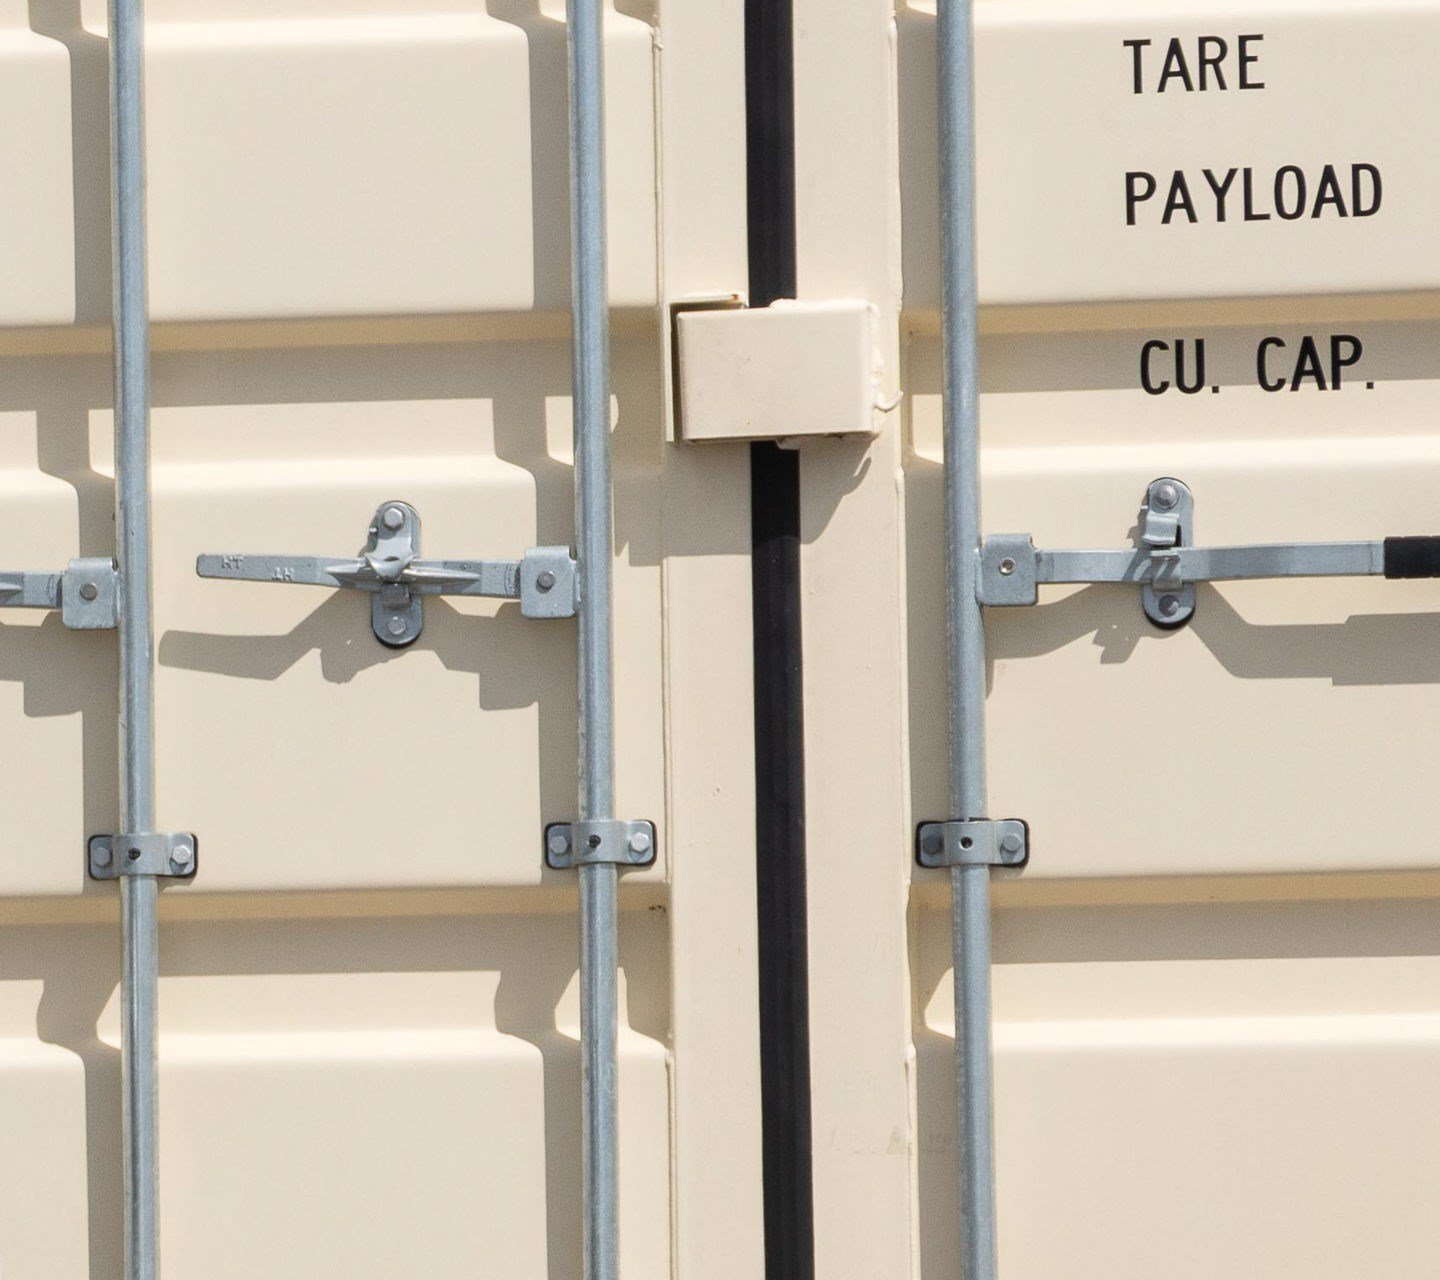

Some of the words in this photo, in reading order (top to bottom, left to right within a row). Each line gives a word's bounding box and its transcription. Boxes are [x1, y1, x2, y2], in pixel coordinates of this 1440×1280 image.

[1123, 34, 1266, 94] TARE
[1126, 163, 1383, 226] PAYLOAD
[1139, 338, 1221, 394] CU.
[1256, 334, 1376, 393] CAP.
